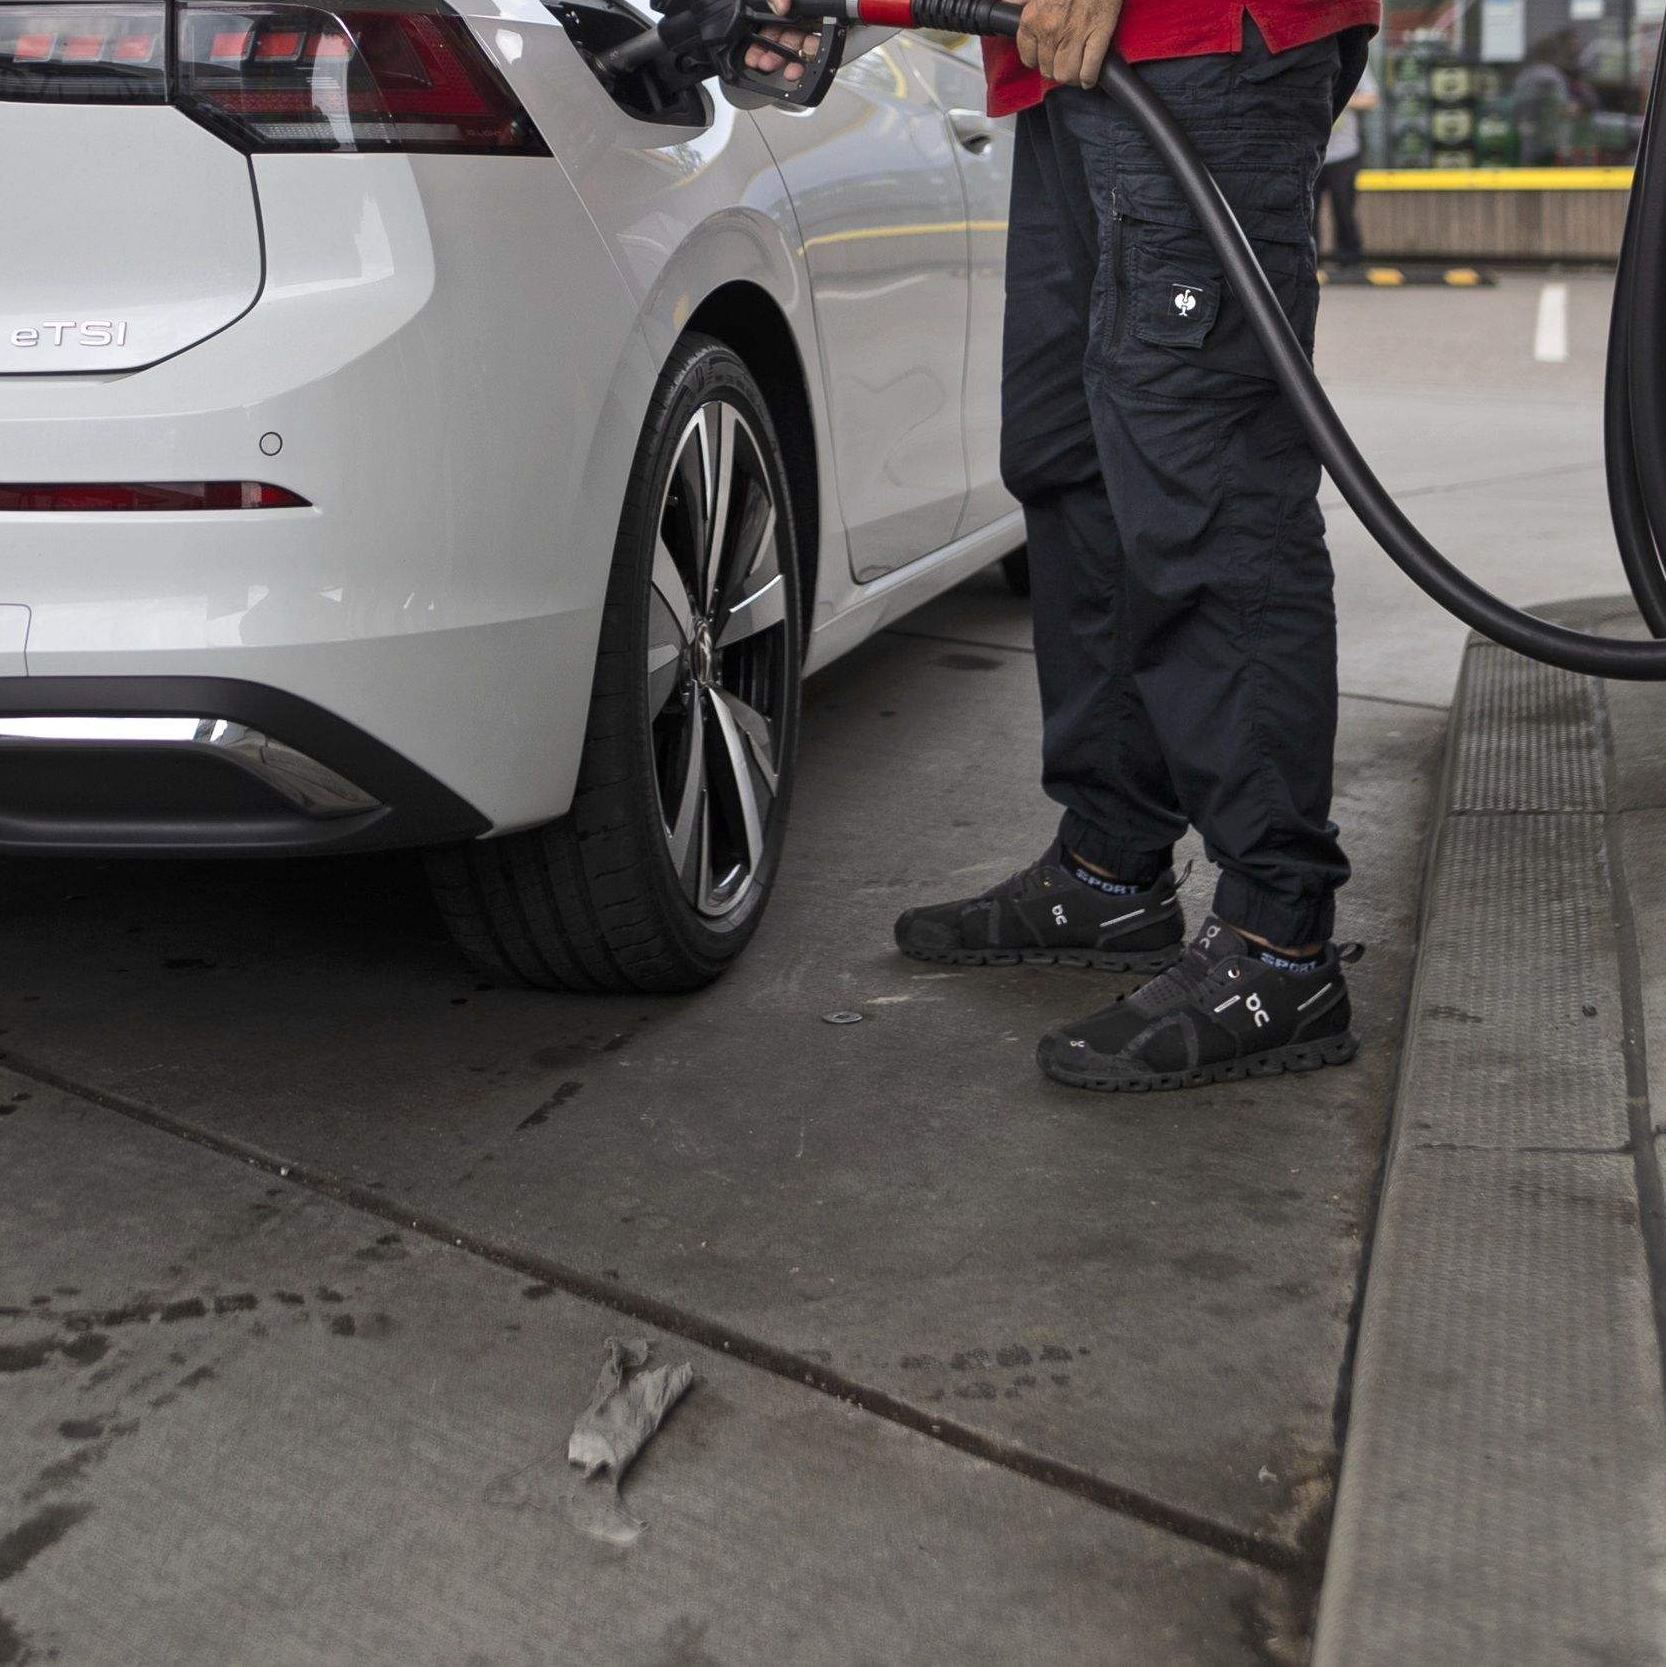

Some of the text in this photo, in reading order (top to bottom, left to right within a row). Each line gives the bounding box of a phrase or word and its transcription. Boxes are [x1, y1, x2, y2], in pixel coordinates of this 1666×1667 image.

[10, 320, 128, 348] eTSI
[1075, 867, 1140, 895] SPORT
[1259, 952, 1318, 974] SPORT
